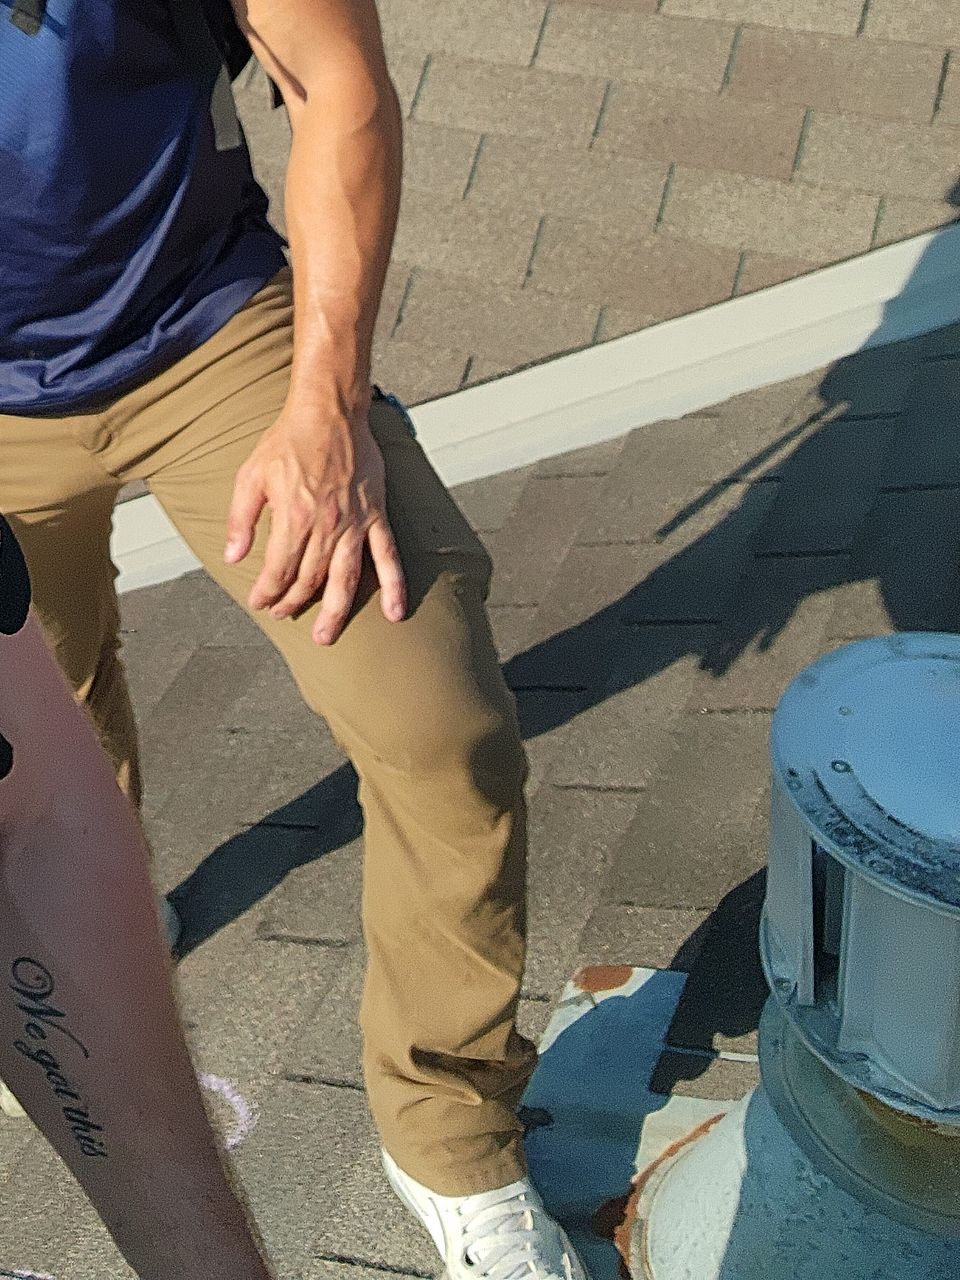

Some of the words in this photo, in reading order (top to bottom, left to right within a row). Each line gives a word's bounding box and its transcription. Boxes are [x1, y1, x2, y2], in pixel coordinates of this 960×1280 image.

[9, 956, 89, 1058] We
[13, 1040, 81, 1101] got
[62, 1105, 108, 1158] this
